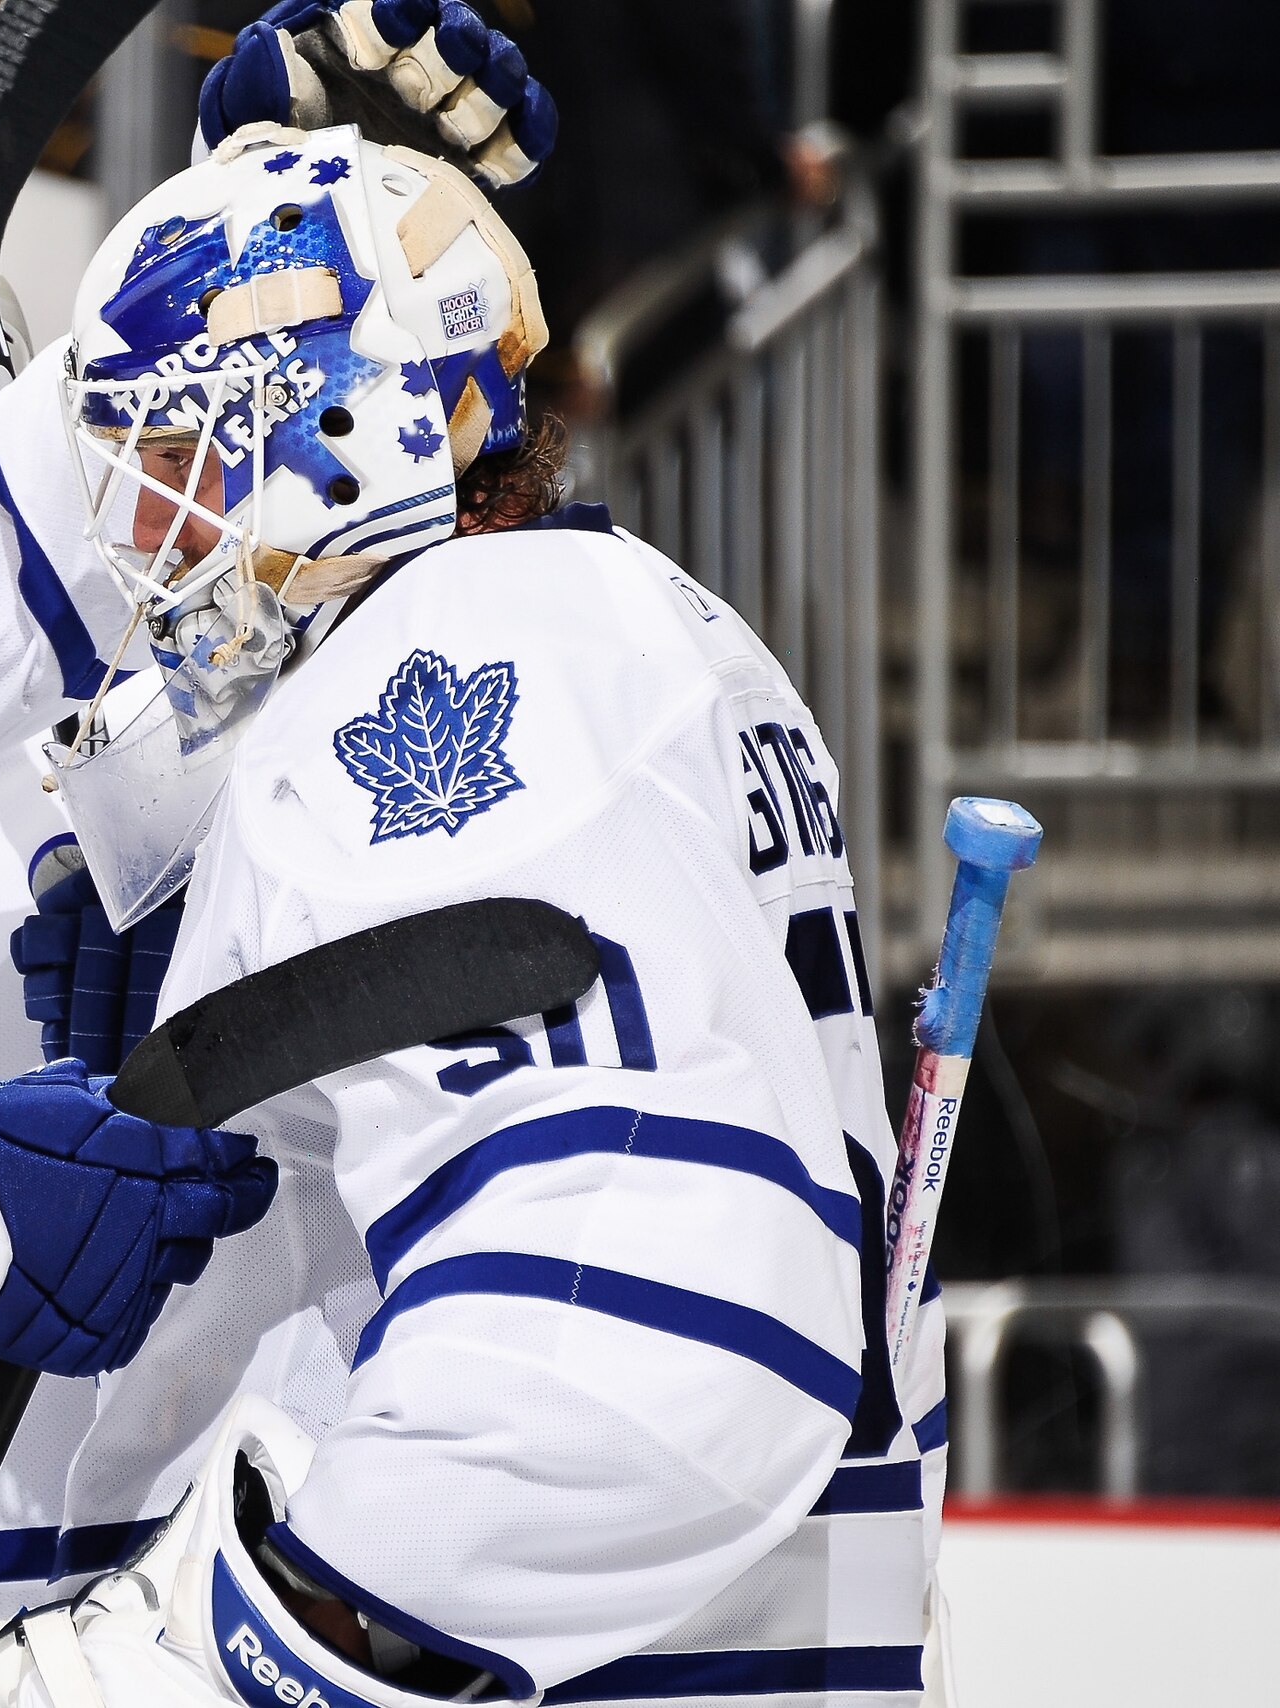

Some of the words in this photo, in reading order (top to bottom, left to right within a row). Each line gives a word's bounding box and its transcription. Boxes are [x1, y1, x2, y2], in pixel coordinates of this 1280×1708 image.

[441, 291, 477, 313] HOCKEY
[442, 304, 479, 326] FIGHTS
[446, 316, 483, 338] CANCER
[167, 331, 297, 431] MAPLE
[923, 1098, 958, 1192] Reebok
[226, 1624, 331, 1708] Reeb
